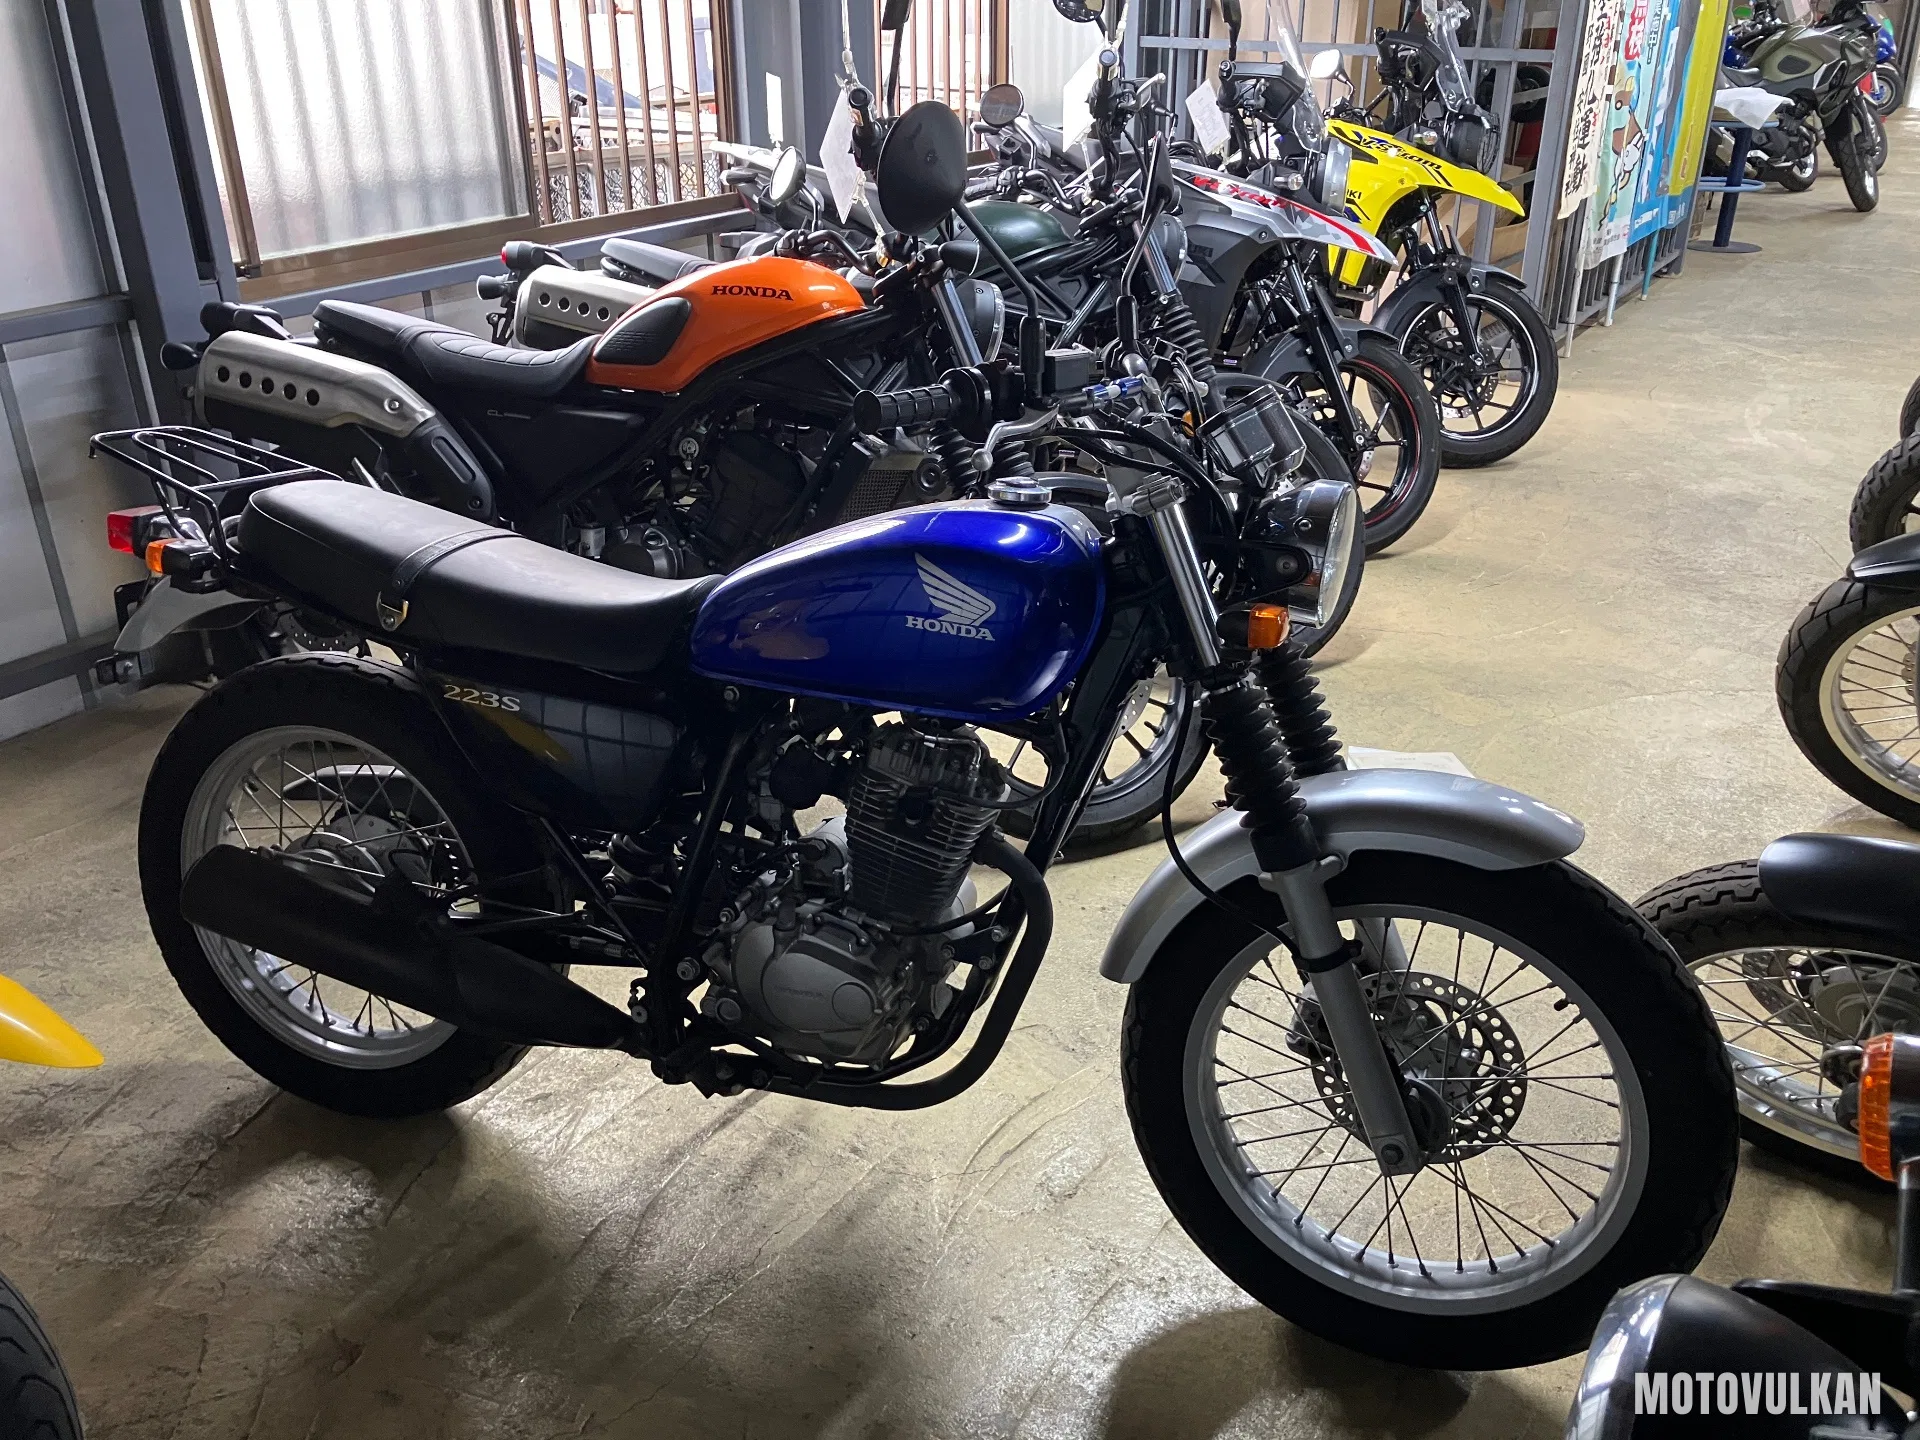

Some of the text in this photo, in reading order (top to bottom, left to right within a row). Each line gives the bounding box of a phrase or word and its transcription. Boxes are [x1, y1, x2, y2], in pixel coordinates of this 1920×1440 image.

[711, 285, 794, 301] HONDA
[905, 615, 996, 642] HONDA
[443, 684, 520, 712] 223S
